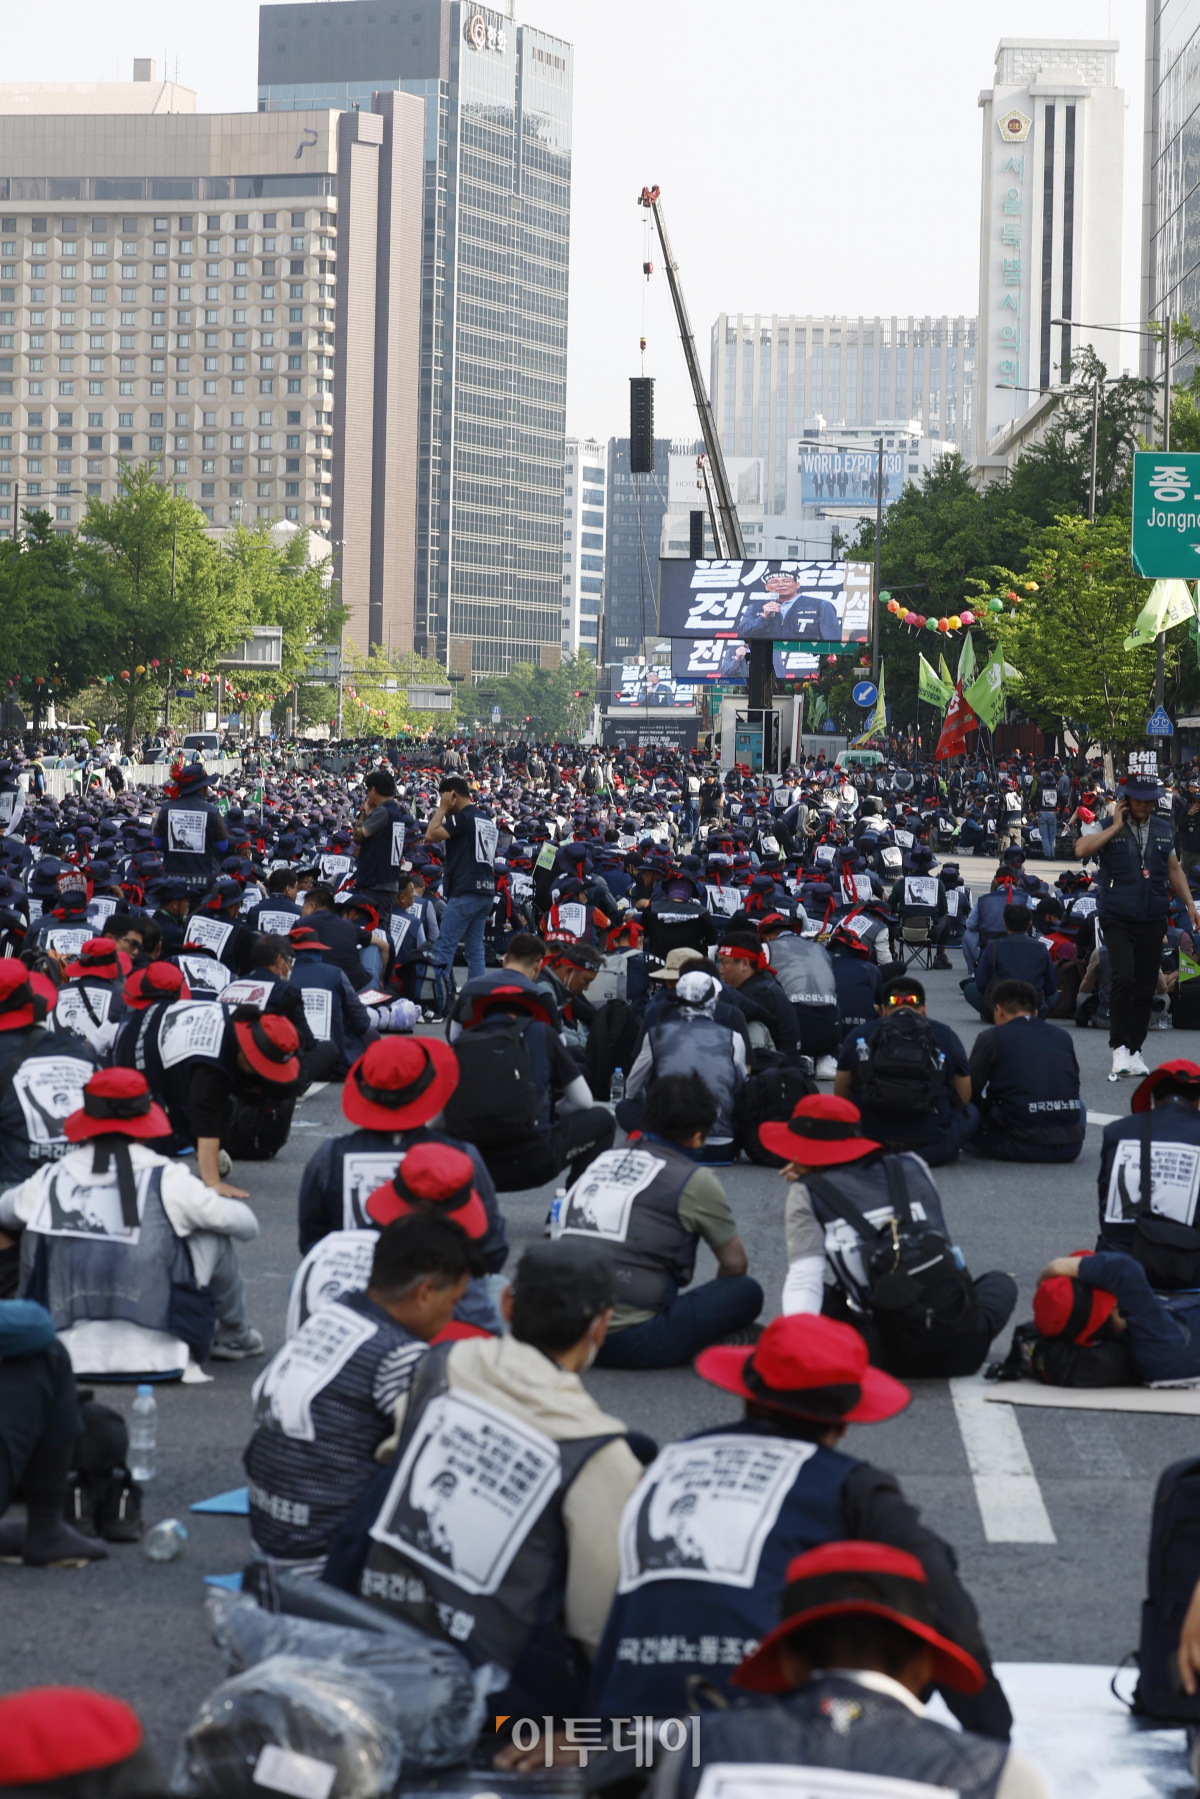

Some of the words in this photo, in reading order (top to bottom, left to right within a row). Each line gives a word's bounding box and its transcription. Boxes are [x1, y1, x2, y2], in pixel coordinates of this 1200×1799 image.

[487, 25, 507, 54] 한화
[1002, 156, 1025, 387] 서울특별시의회
[803, 454, 842, 474] WORLD
[844, 454, 872, 473] EXPO
[875, 454, 902, 473] 2030
[1149, 466, 1200, 502] 종
[1129, 750, 1157, 765] 윤석열
[1144, 764, 1158, 776] 퇴진
